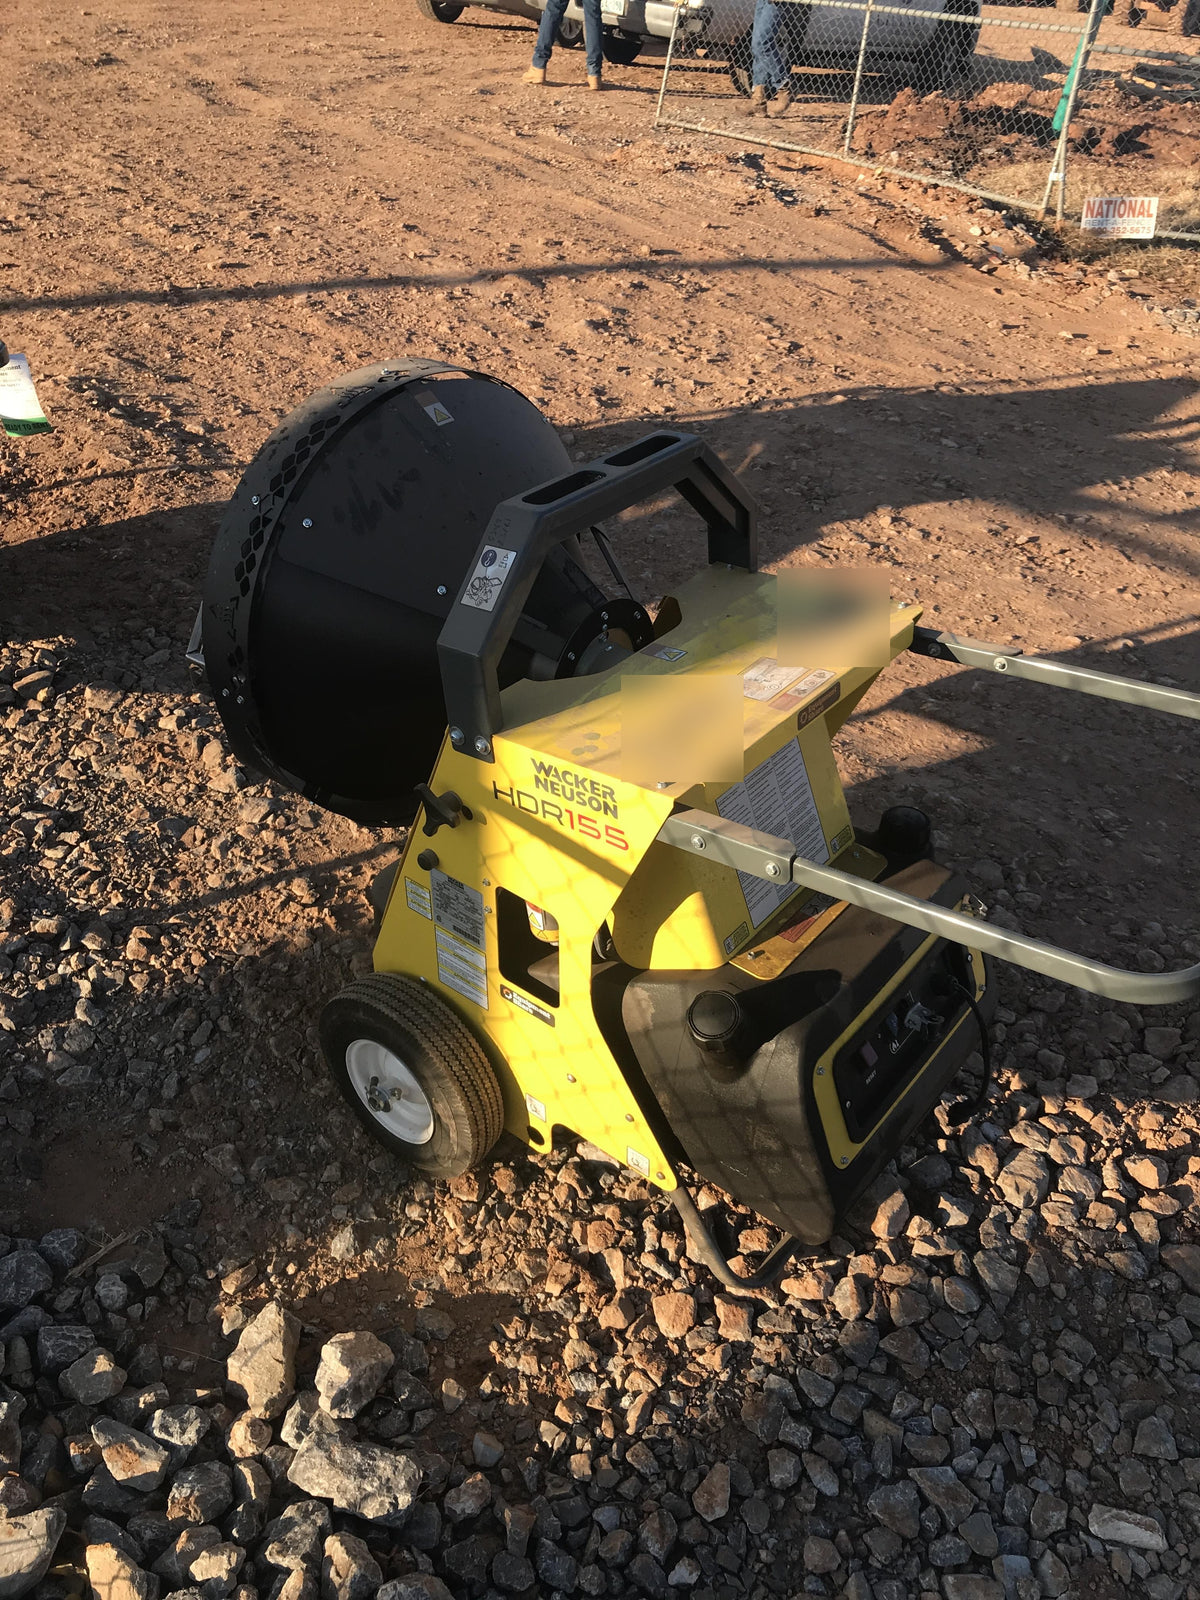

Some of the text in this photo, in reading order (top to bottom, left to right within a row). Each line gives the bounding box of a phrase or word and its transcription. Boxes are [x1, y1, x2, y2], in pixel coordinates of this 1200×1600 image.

[1085, 200, 1153, 218] NATIONAL
[531, 757, 618, 804] WACKER
[534, 774, 619, 820] NEUSON
[493, 780, 629, 851] HDR155
